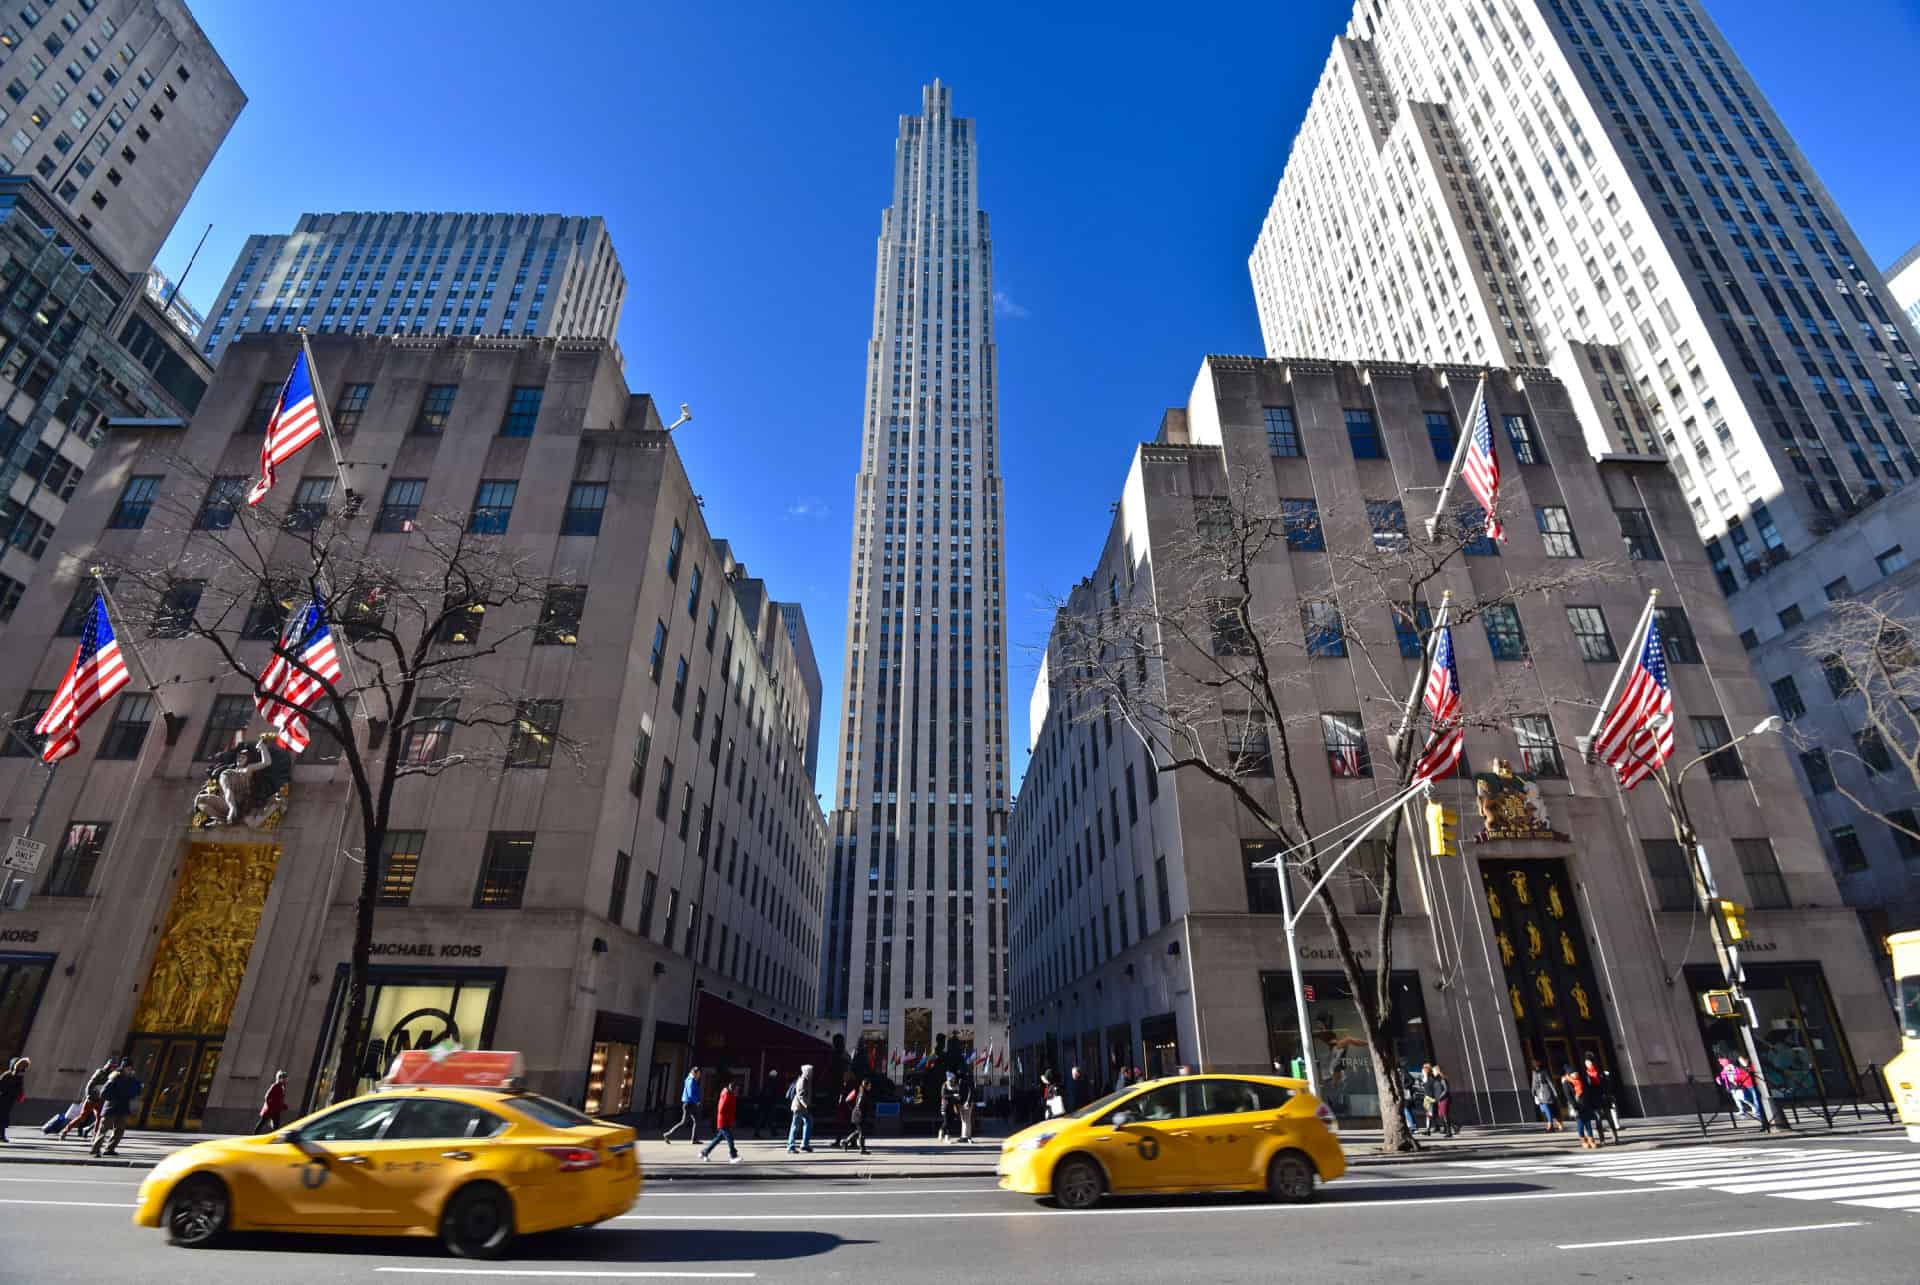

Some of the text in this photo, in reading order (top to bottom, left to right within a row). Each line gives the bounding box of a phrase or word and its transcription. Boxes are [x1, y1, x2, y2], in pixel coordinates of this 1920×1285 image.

[15, 849, 35, 860] ONLY
[368, 943, 483, 957] MICHAEL KORS
